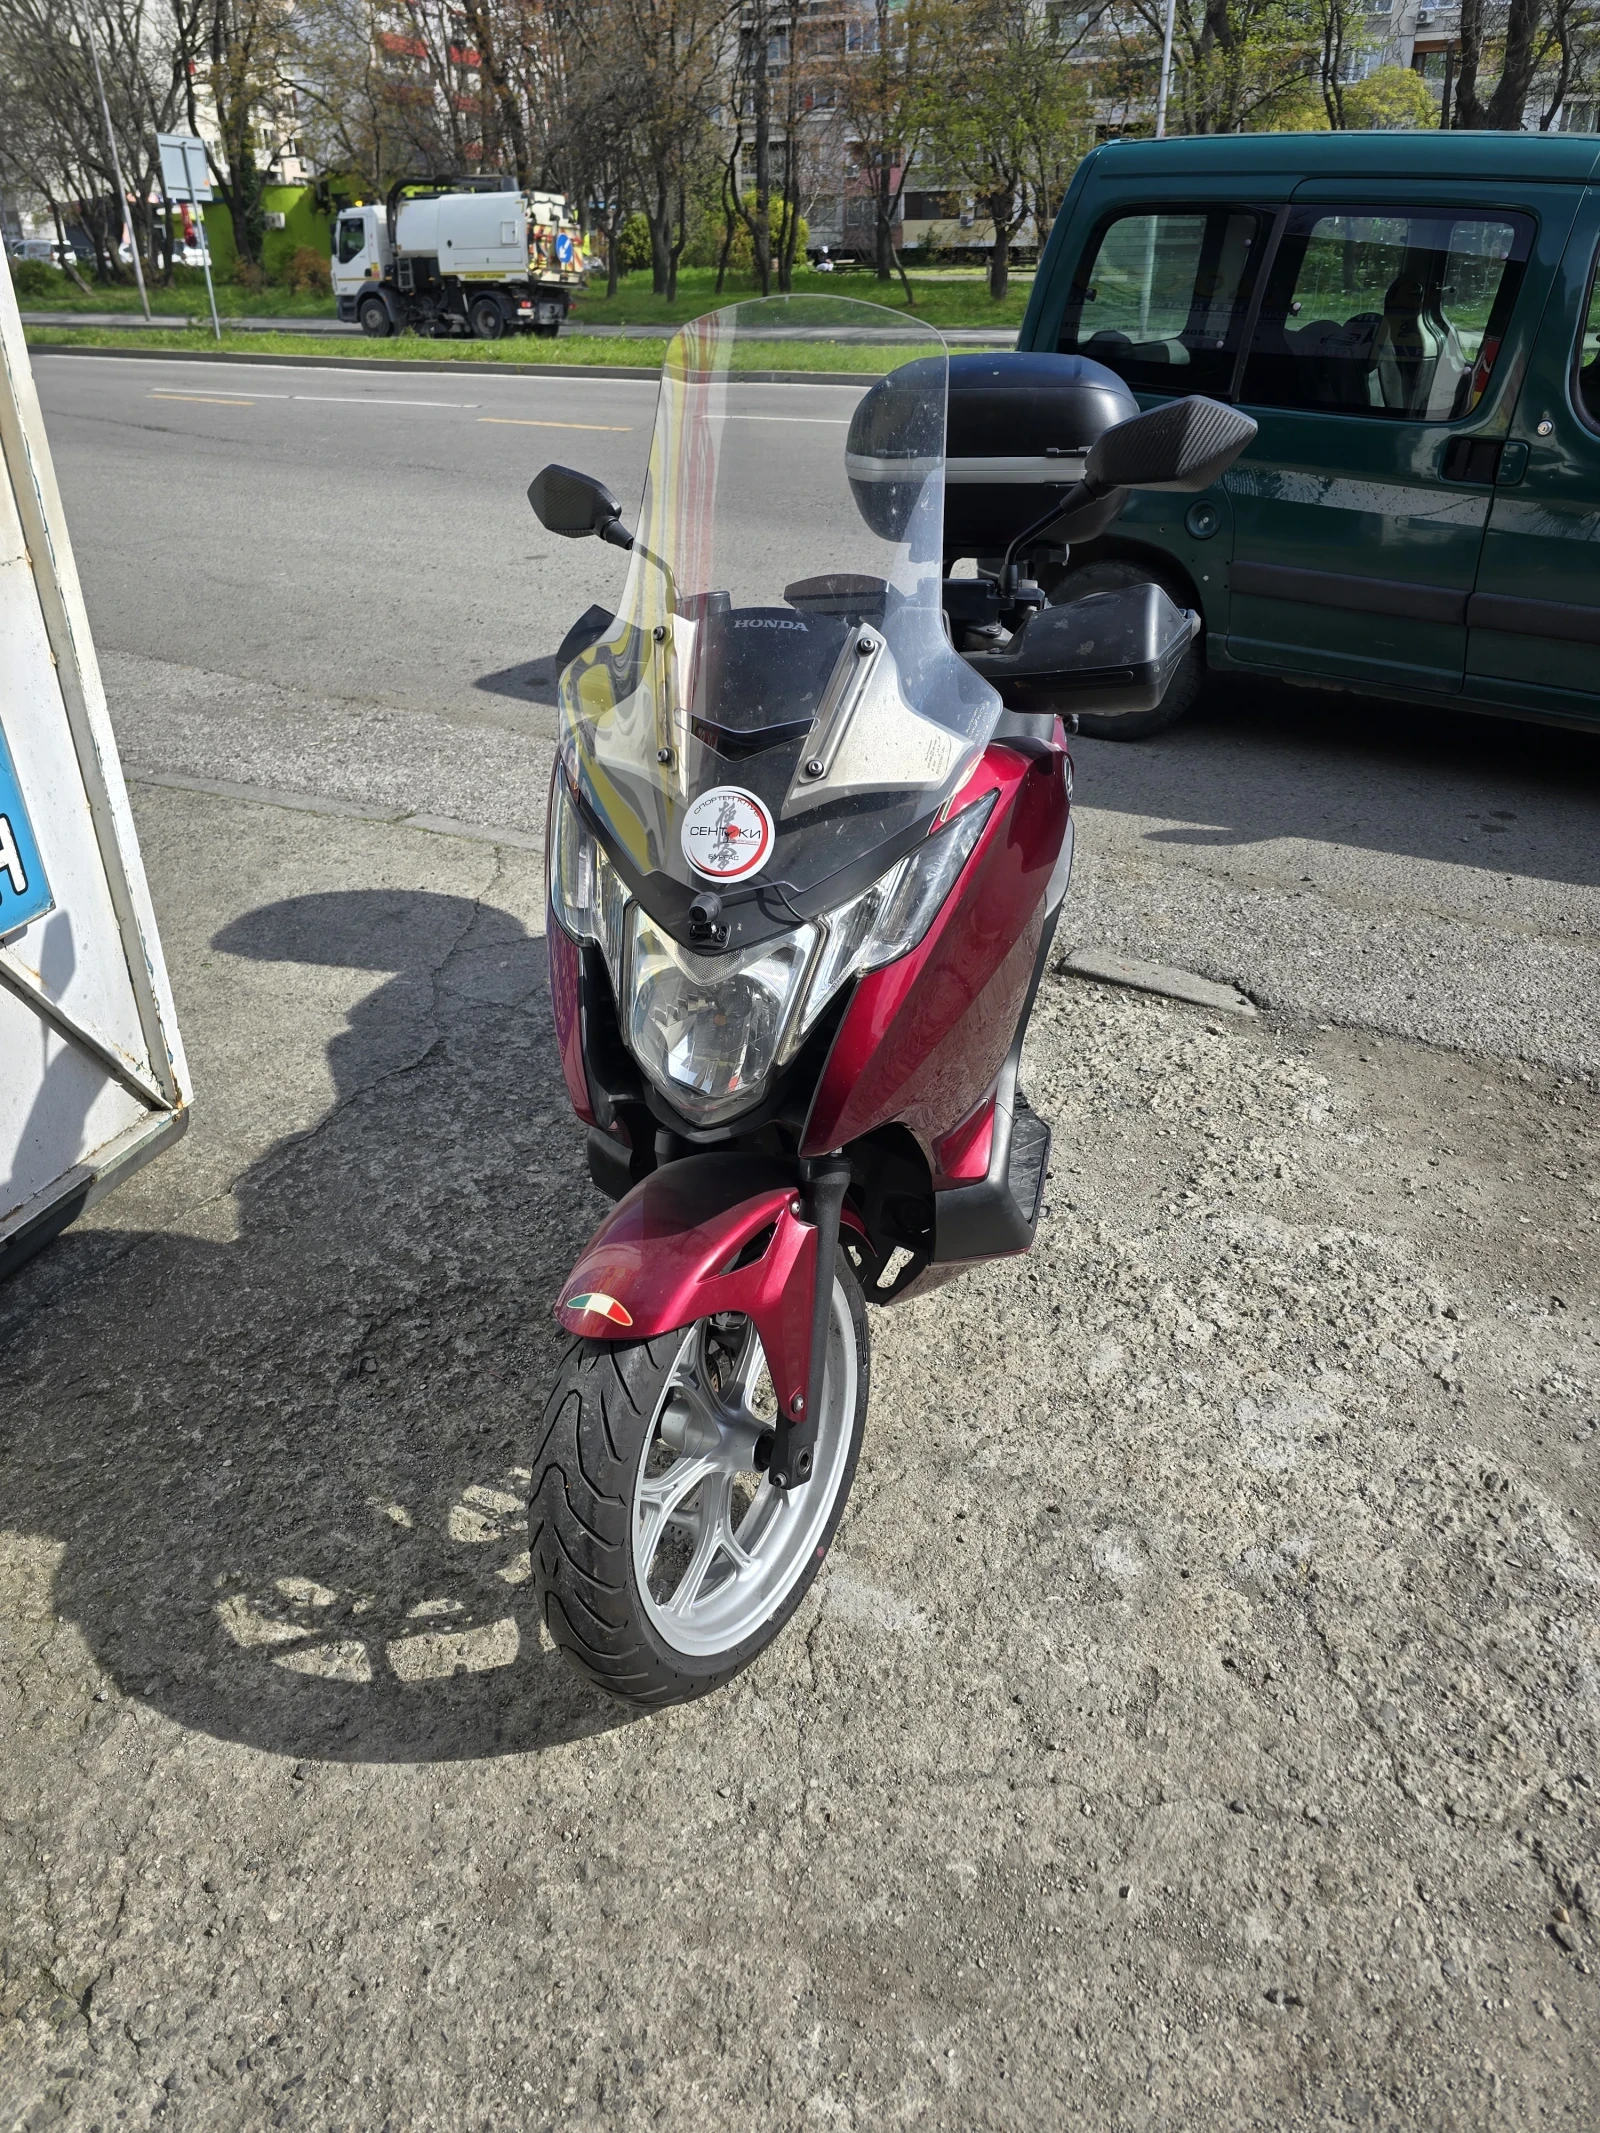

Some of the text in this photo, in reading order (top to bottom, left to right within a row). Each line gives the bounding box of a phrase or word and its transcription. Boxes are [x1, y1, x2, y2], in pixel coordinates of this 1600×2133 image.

[733, 618, 810, 632] HONDA
[693, 795, 761, 818] СПОРТЕН КЛУБ
[707, 853, 740, 862] БУРГАС
